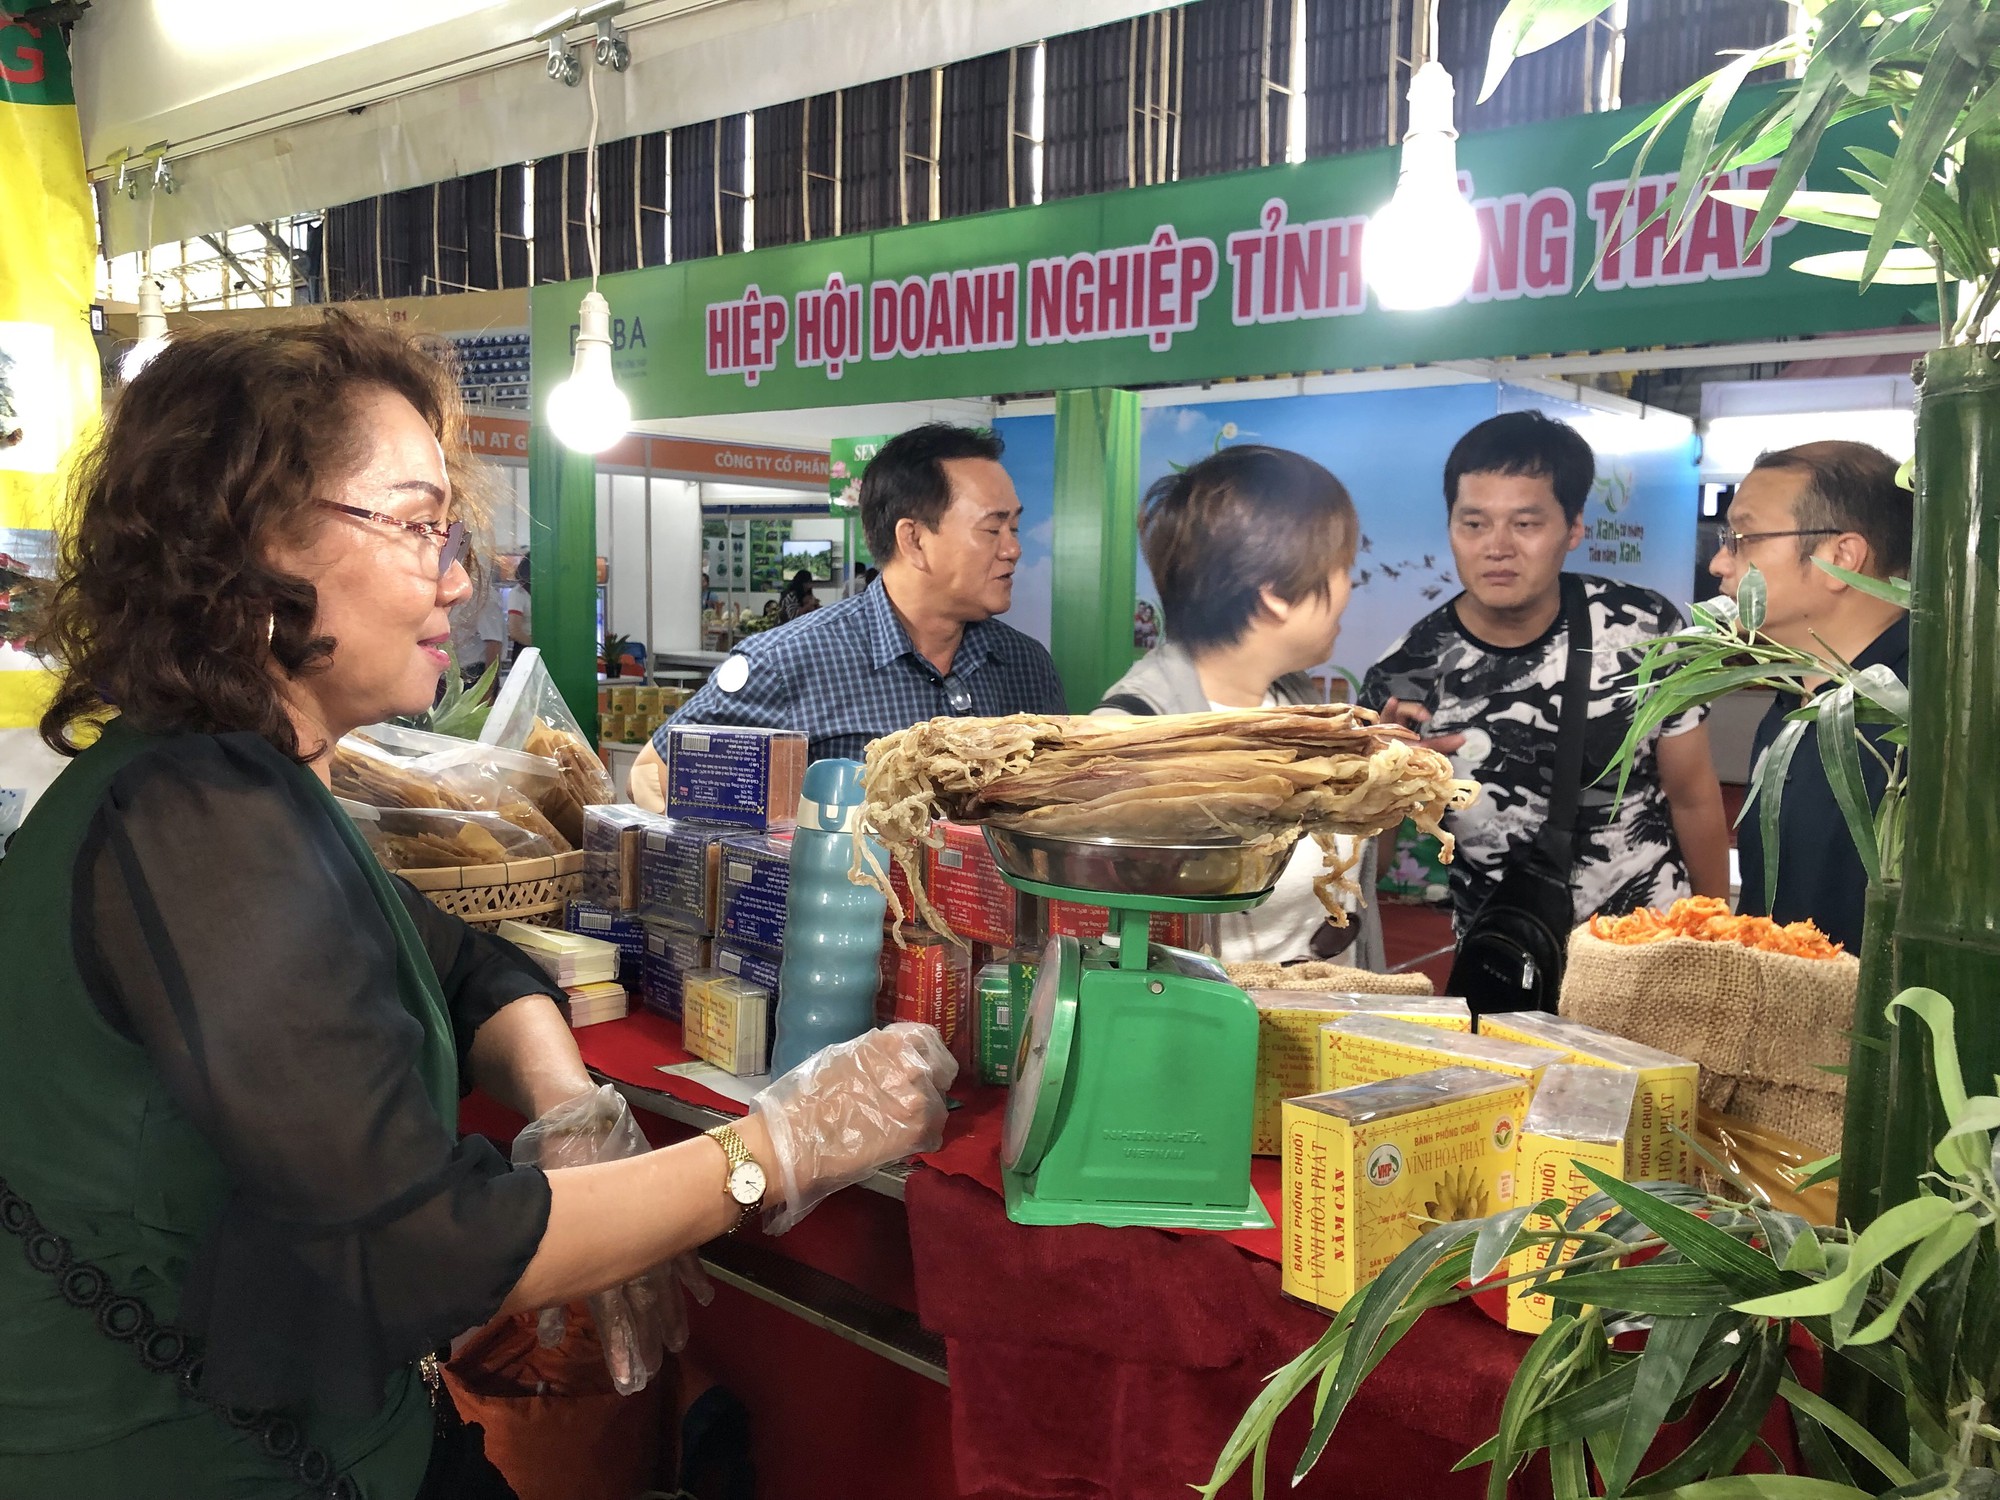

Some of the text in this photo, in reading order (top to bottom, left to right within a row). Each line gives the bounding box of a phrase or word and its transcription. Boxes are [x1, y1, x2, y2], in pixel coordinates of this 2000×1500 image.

[707, 287, 787, 384] HIỆP
[797, 275, 861, 377] HỘI
[871, 266, 1017, 358] DOANH
[1028, 228, 1216, 349] NGHIỆP
[1229, 200, 1367, 322] TỈNH
[490, 431, 511, 448] AT
[715, 451, 753, 468] CÔNG
[756, 456, 771, 471] TY
[1596, 517, 1619, 540] Xanh
[1620, 541, 1641, 562] Xanh
[935, 962, 943, 983] TÔM
[933, 987, 943, 1019] PHỒNG
[1414, 1120, 1480, 1147] BÁNH PHỒNG CHUỐI
[1638, 1092, 1653, 1177] PHỒNG CHUỐI
[1377, 1163, 1392, 1179] VHP
[1406, 1134, 1486, 1175] VĨNH HÒA PHÁT
[1655, 1139, 1673, 1173] HÒA
[1539, 1163, 1556, 1200] HUỐI
[1292, 1133, 1303, 1272] BÁNH PHỒNG CHUỐI
[1307, 1141, 1327, 1279] VĨNH HÒA PHÁT
[1331, 1169, 1345, 1262] NĂM CĂN
